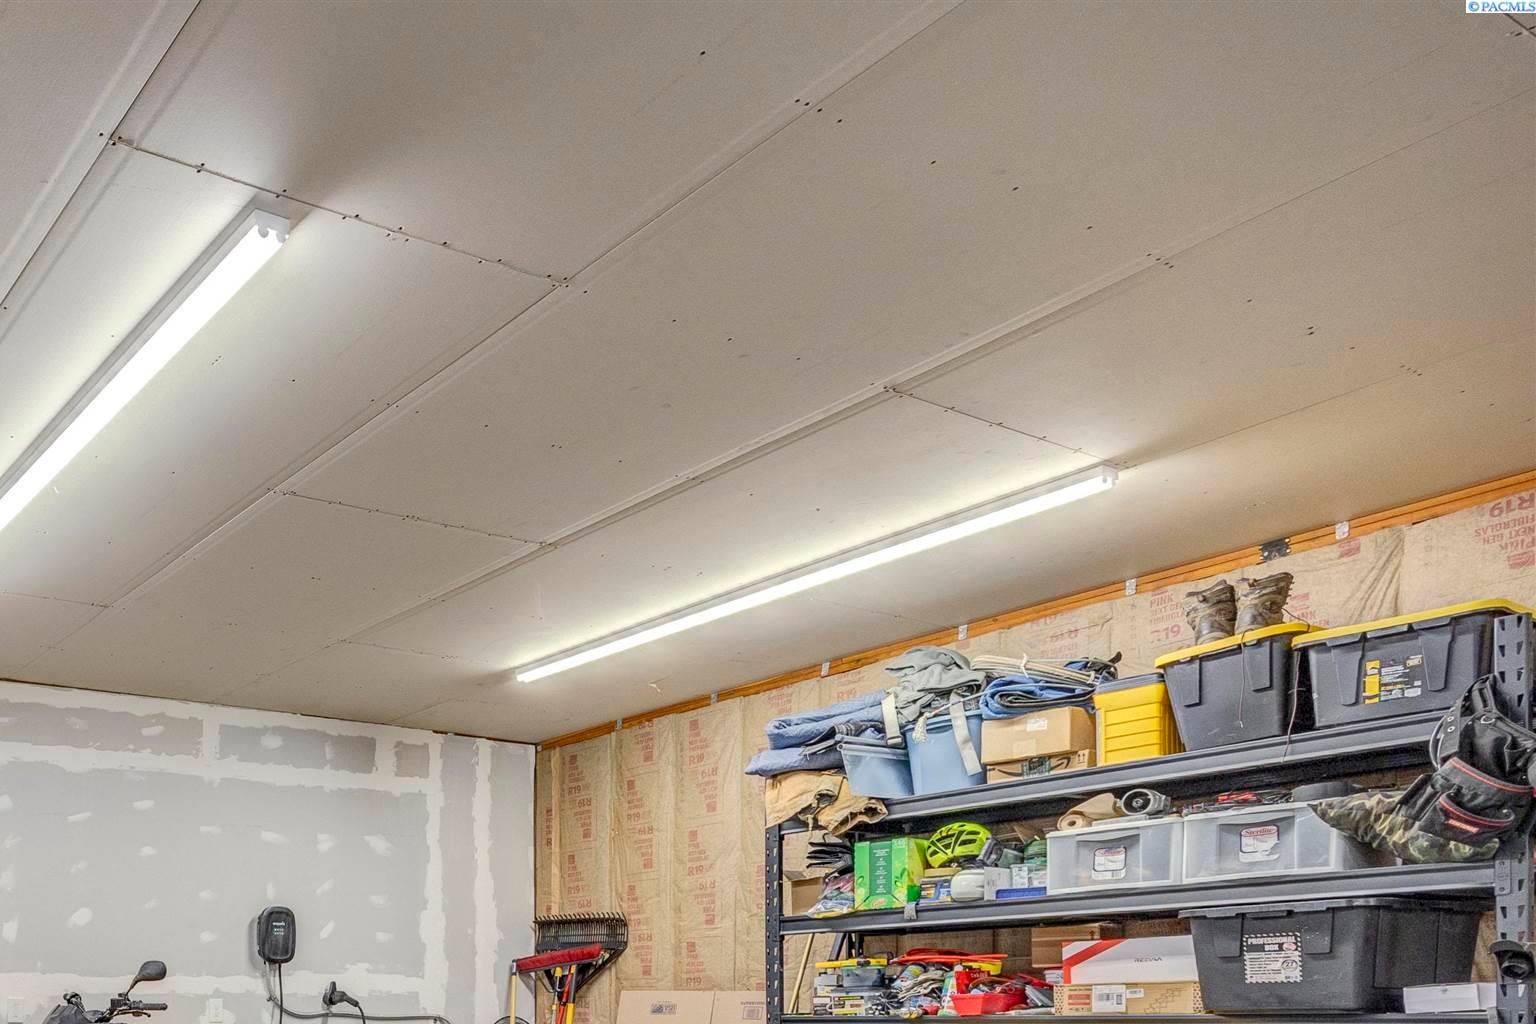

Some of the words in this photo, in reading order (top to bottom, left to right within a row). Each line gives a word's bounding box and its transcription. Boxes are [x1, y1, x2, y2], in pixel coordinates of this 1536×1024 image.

[1490, 492, 1536, 518] R19
[1509, 525, 1536, 540] NEXT
[1499, 536, 1536, 552] PINK
[577, 797, 592, 809] R19
[577, 900, 592, 909] R19
[1248, 936, 1296, 944] PROFESSIONAL
